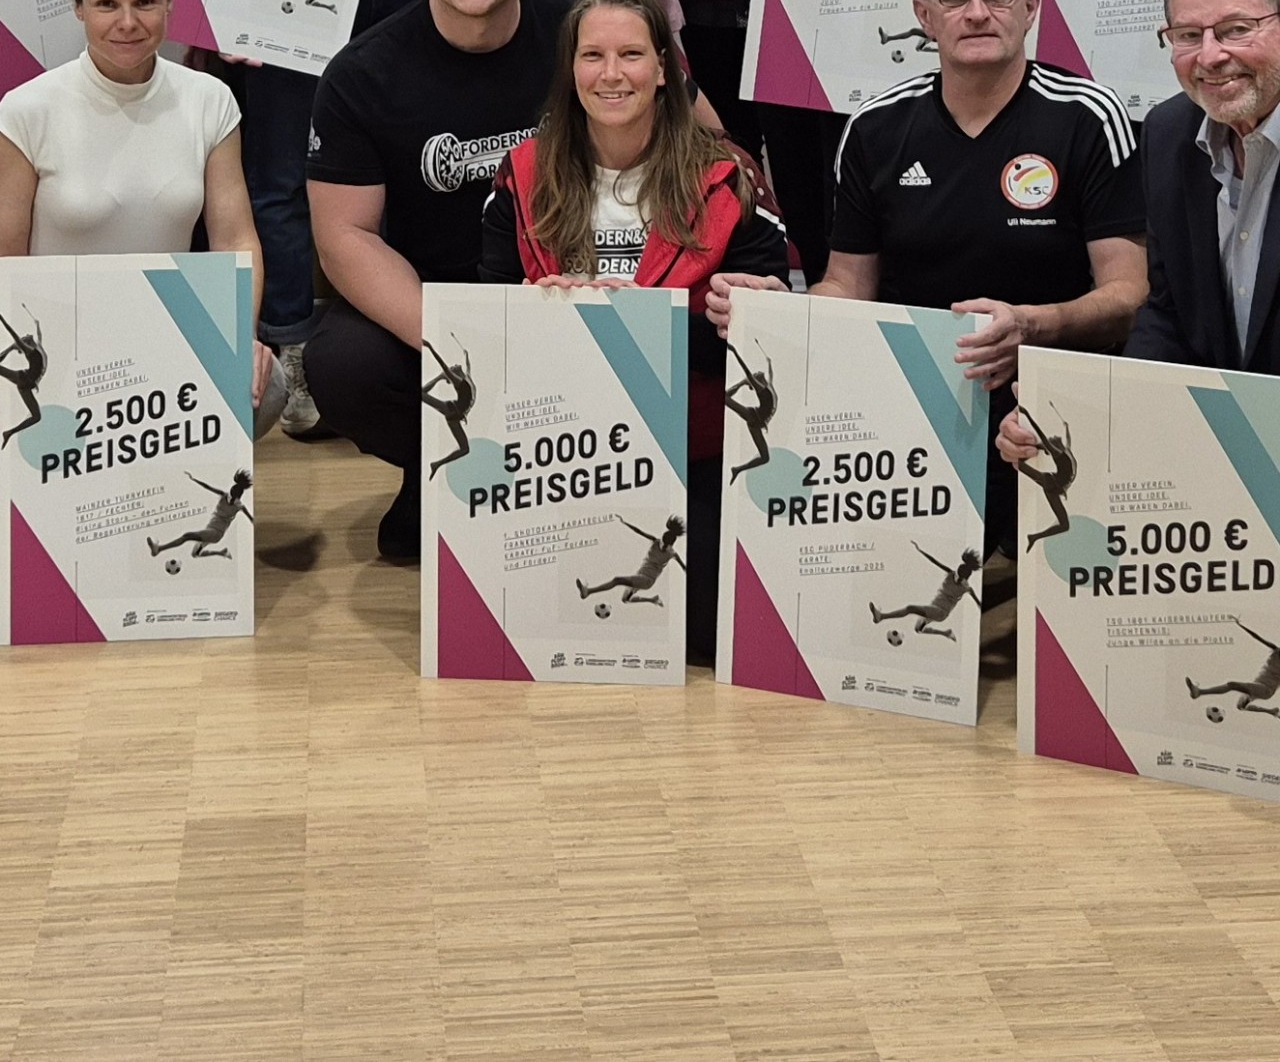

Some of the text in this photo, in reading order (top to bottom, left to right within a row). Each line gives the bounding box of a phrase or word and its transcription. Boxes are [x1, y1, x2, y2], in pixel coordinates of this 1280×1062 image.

[597, 257, 640, 274] DERN
[75, 382, 198, 439] 2.500 €
[41, 414, 221, 484] PREISGELD
[503, 423, 630, 473] 5.000 €
[802, 447, 928, 487] 2.500 €
[469, 457, 654, 519] PREISGELD
[767, 485, 951, 528] PREISGELD
[1106, 519, 1248, 557] 5.000 €
[1069, 558, 1275, 598] PREISGELD
